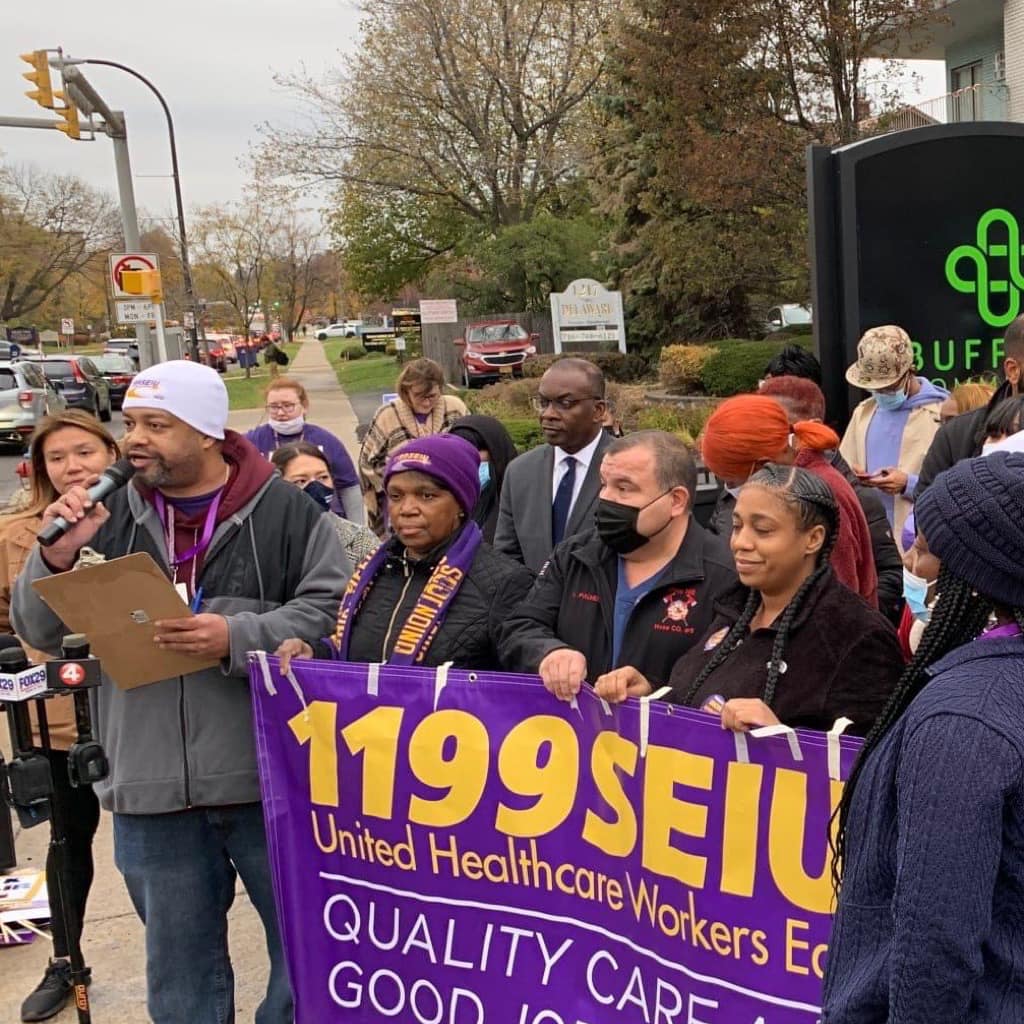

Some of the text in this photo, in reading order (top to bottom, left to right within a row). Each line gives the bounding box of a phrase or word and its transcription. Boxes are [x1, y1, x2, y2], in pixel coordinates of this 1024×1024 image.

[394, 605, 438, 655] UNION
[19, 670, 46, 687] FOX29
[62, 663, 81, 682] 4
[287, 700, 844, 914] 1199SEIU
[311, 810, 416, 872] United
[429, 832, 624, 911] Healthcare
[625, 872, 769, 965] Workers
[323, 893, 574, 986] QUALITY
